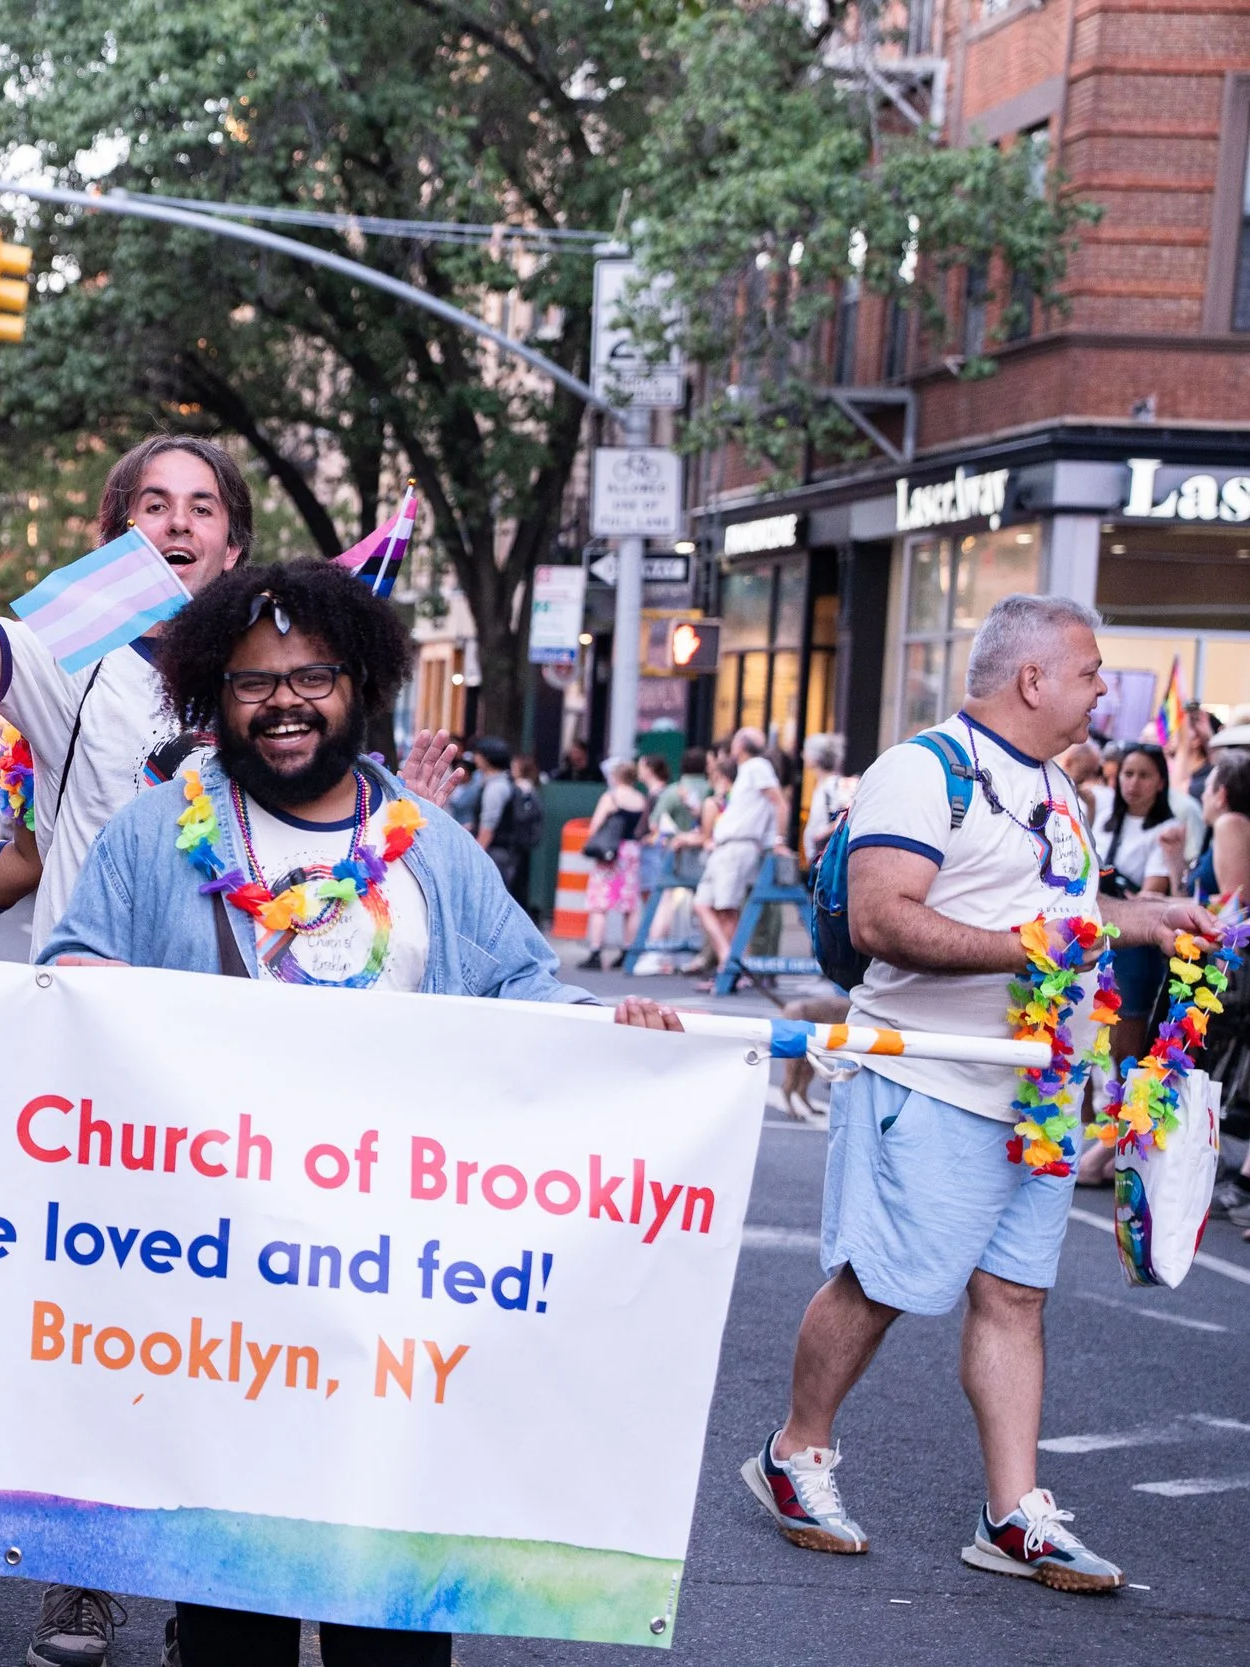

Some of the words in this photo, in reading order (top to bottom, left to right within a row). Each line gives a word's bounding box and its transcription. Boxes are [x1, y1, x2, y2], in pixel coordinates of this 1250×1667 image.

[16, 1094, 273, 1182] Church
[303, 1129, 379, 1193] of
[409, 1135, 716, 1245] Brooklyn
[44, 1200, 232, 1280] loved
[257, 1234, 392, 1295] and
[417, 1239, 554, 1315] fed!
[30, 1299, 340, 1402] Brooklyn,
[374, 1333, 471, 1405] NY
